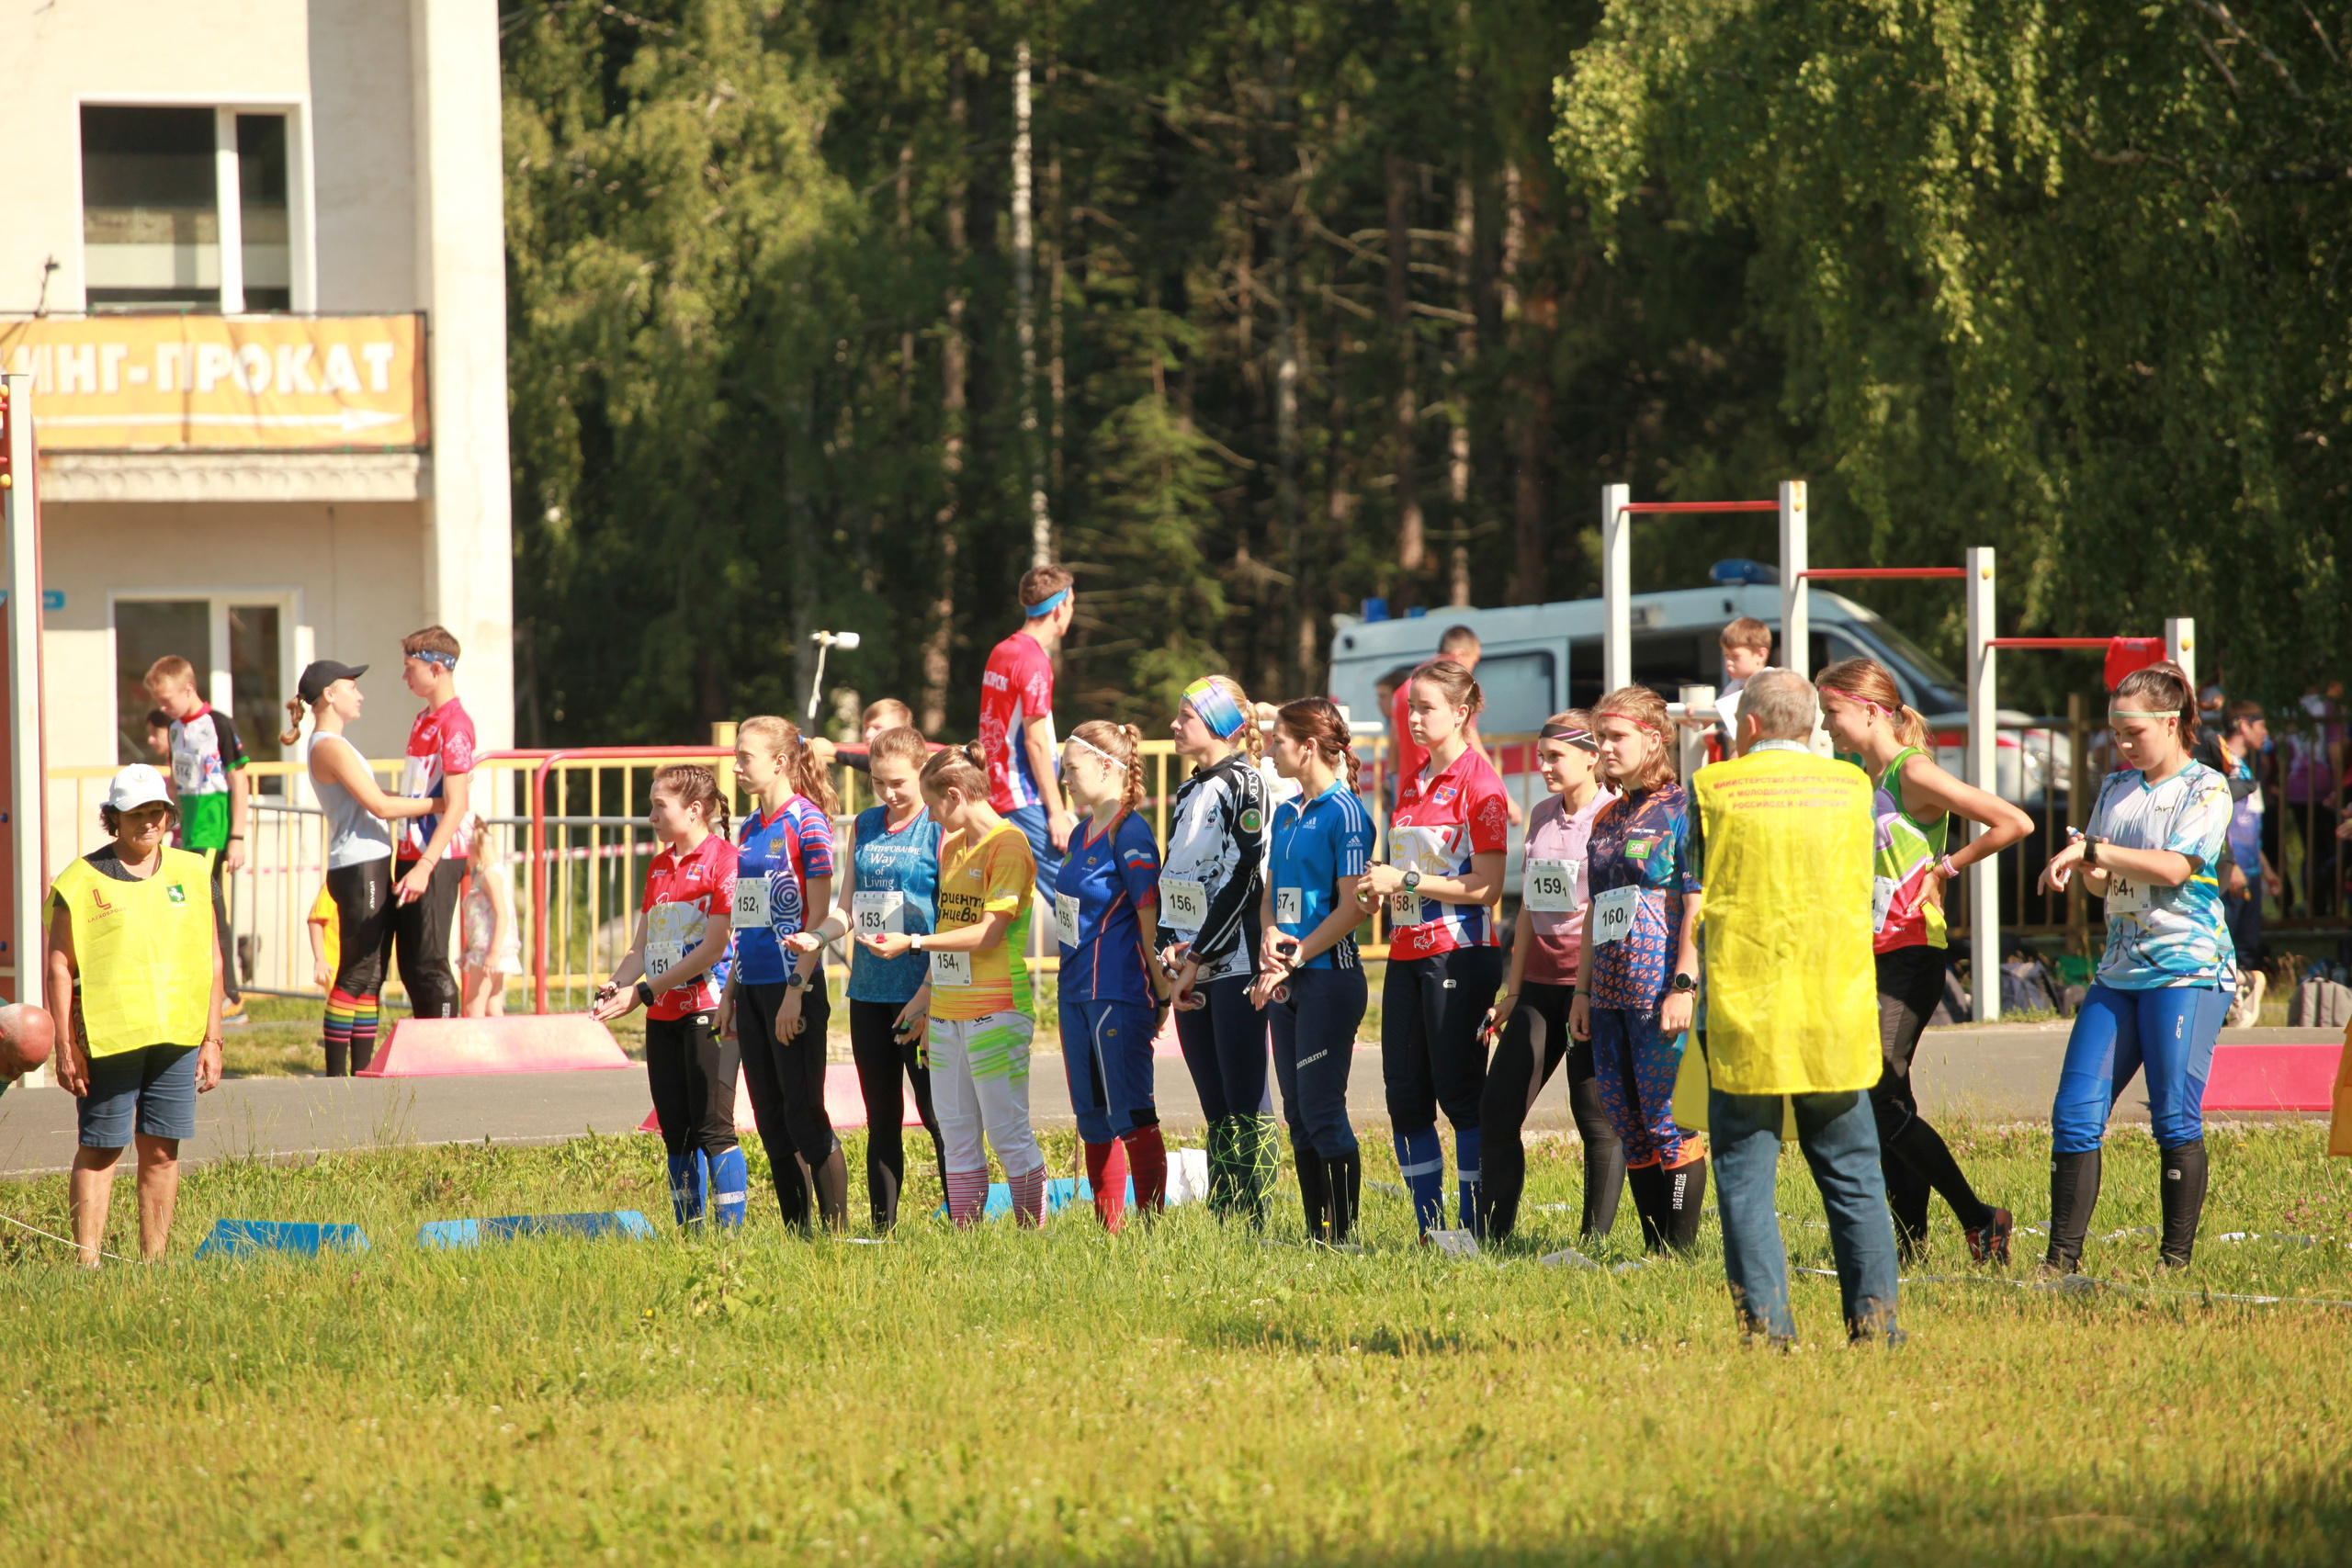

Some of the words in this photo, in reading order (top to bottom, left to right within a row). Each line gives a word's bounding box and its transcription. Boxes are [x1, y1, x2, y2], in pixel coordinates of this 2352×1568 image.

[0, 342, 395, 396] ИНГ-ПРОКАТ
[1630, 842, 1645, 852] SFR
[870, 853, 897, 867] Way
[875, 865, 885, 875] of
[865, 876, 895, 891] Living
[941, 889, 985, 908] риент
[1672, 1173, 1687, 1210] noname
